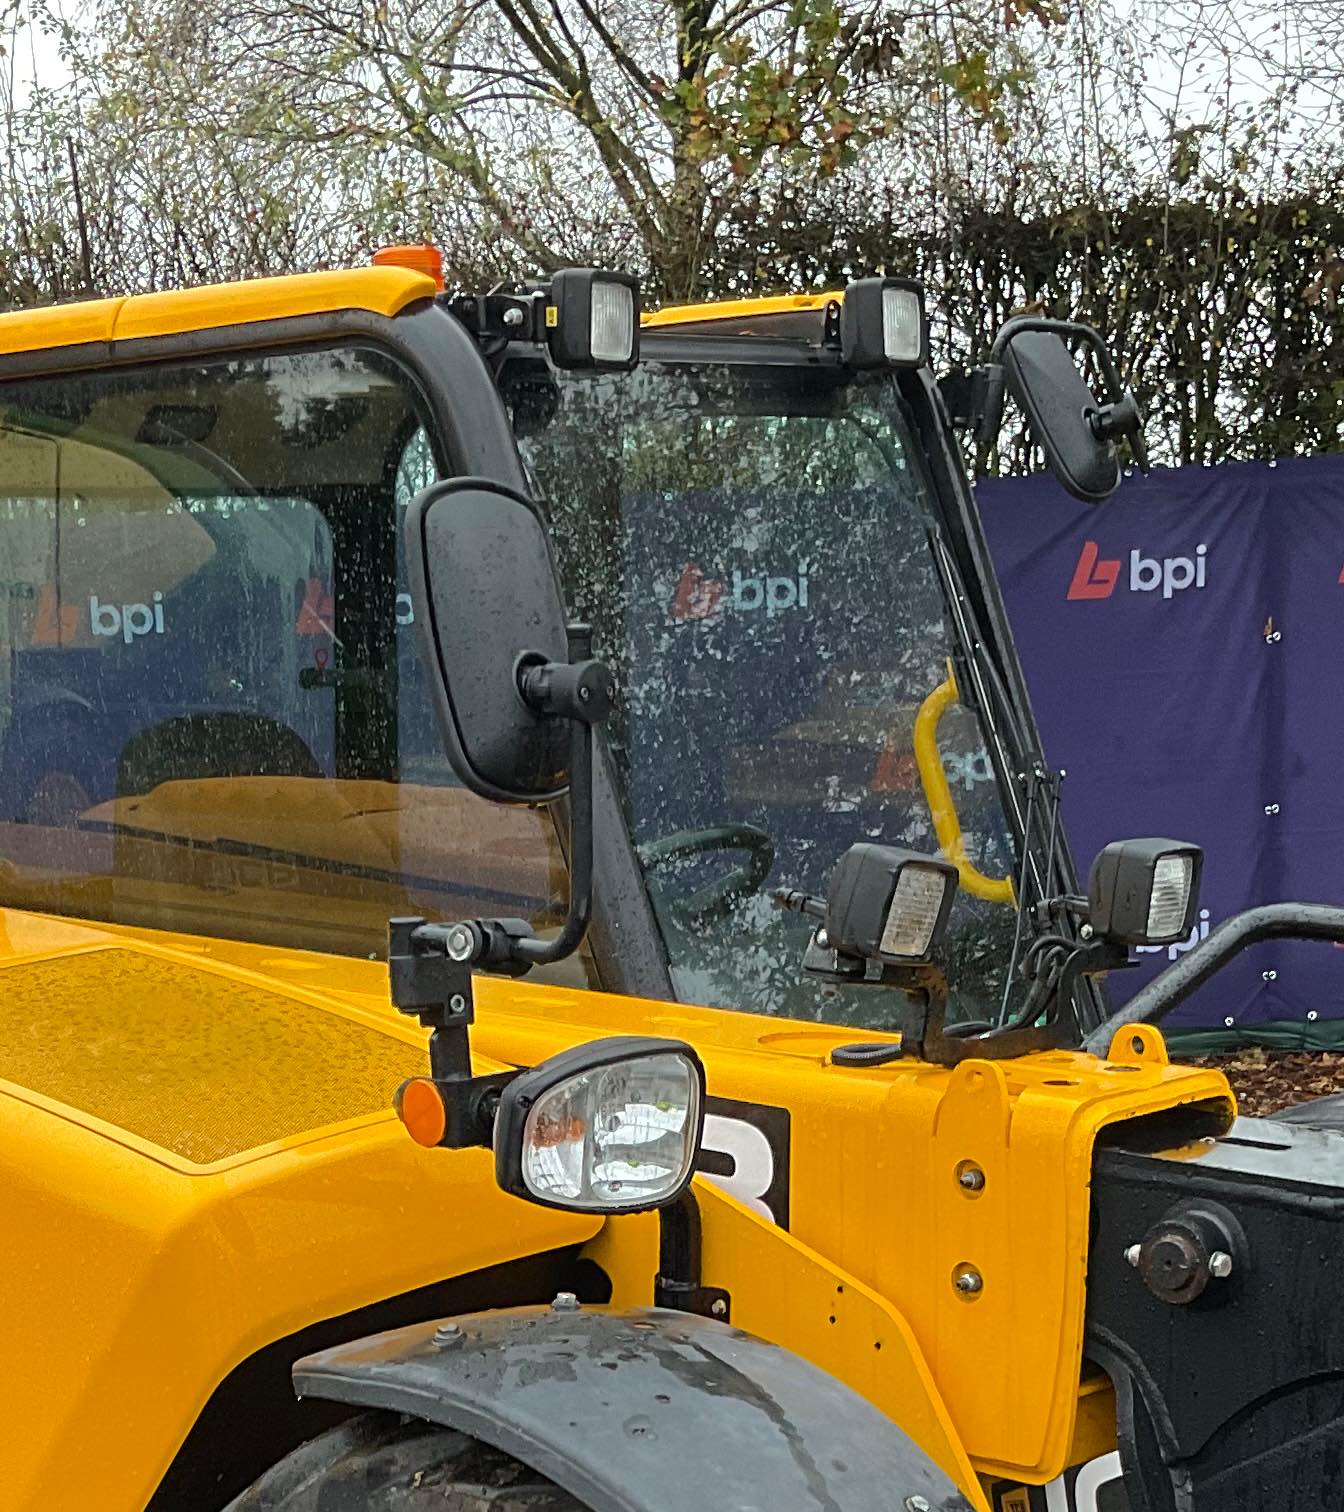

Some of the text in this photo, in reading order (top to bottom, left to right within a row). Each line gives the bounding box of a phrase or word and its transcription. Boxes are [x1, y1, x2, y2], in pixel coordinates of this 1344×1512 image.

[731, 561, 808, 618] bpi
[1130, 543, 1207, 599] bpi
[90, 590, 164, 644] bpi
